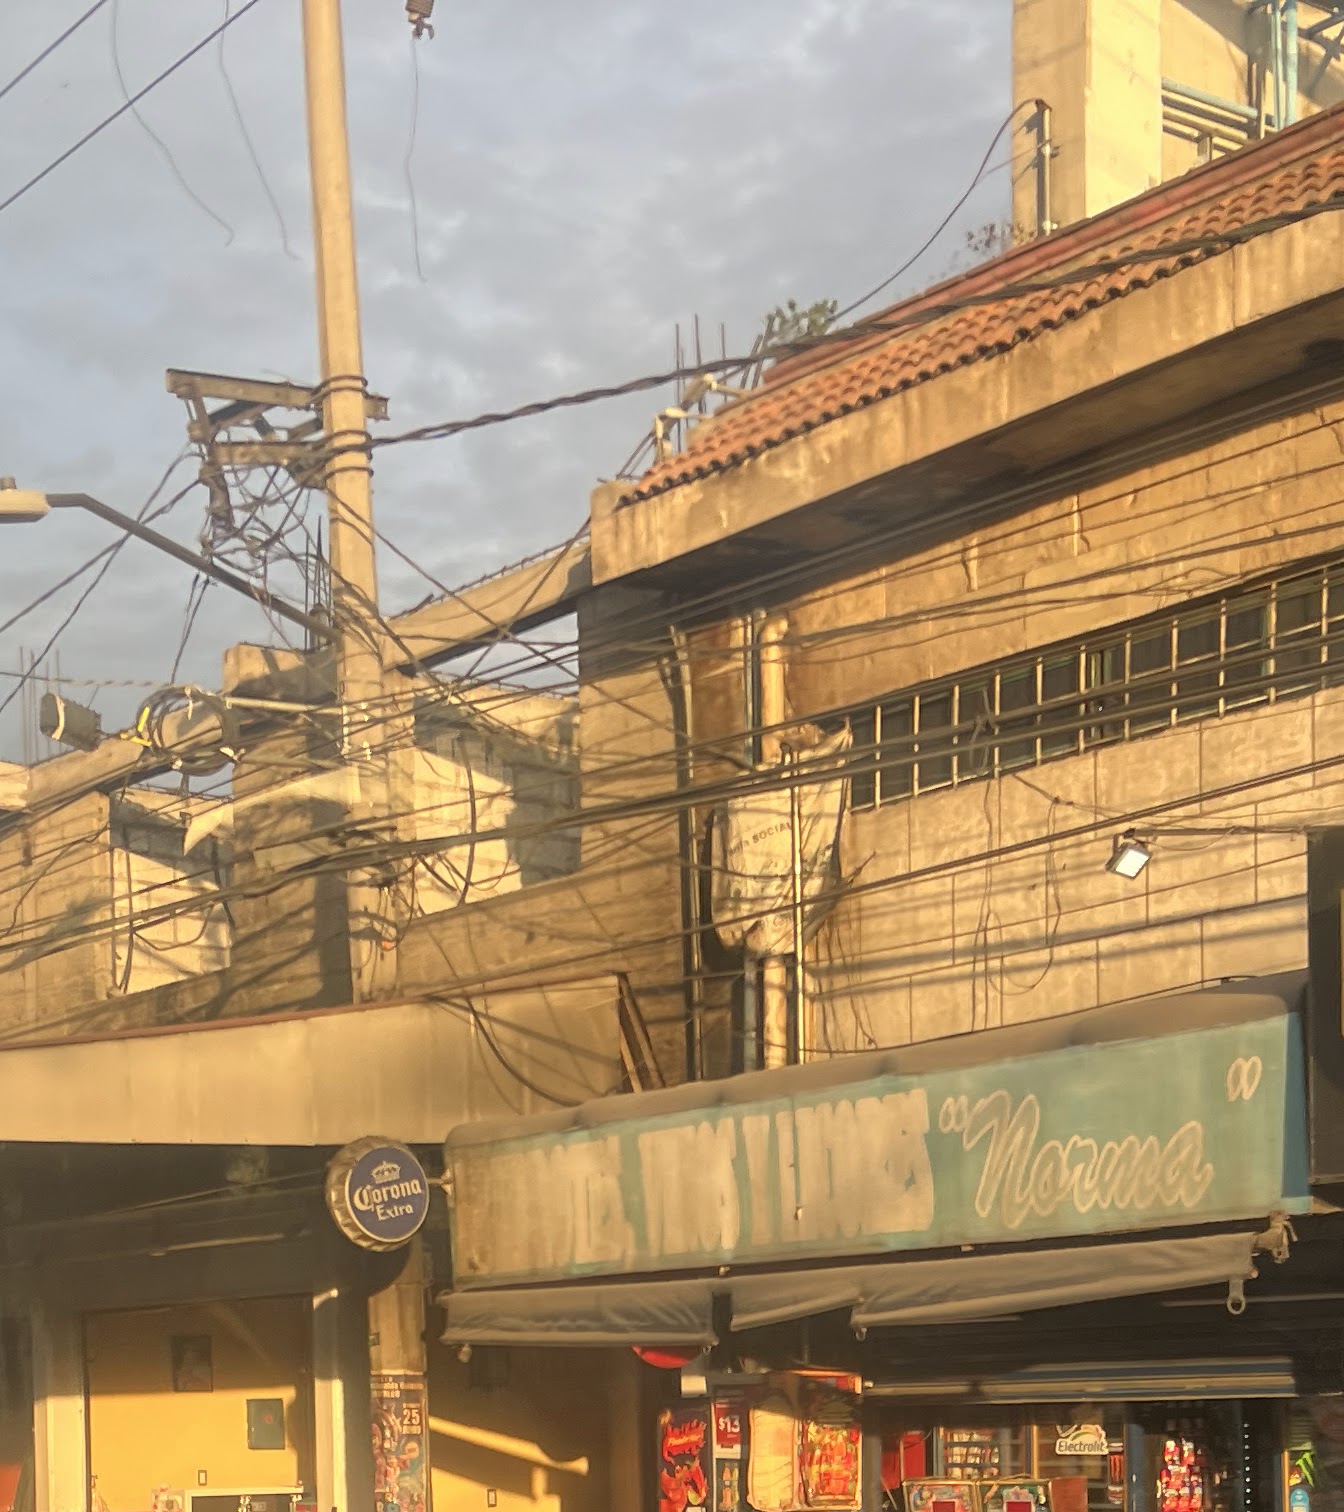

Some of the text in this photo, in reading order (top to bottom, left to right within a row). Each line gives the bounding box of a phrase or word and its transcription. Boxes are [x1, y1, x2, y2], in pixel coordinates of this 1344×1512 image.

[353, 1179, 422, 1212] Corona
[376, 1204, 414, 1221] Extra
[402, 1408, 421, 1425] 25
[718, 1415, 741, 1438] $13
[1058, 1440, 1105, 1452] Electrolit
